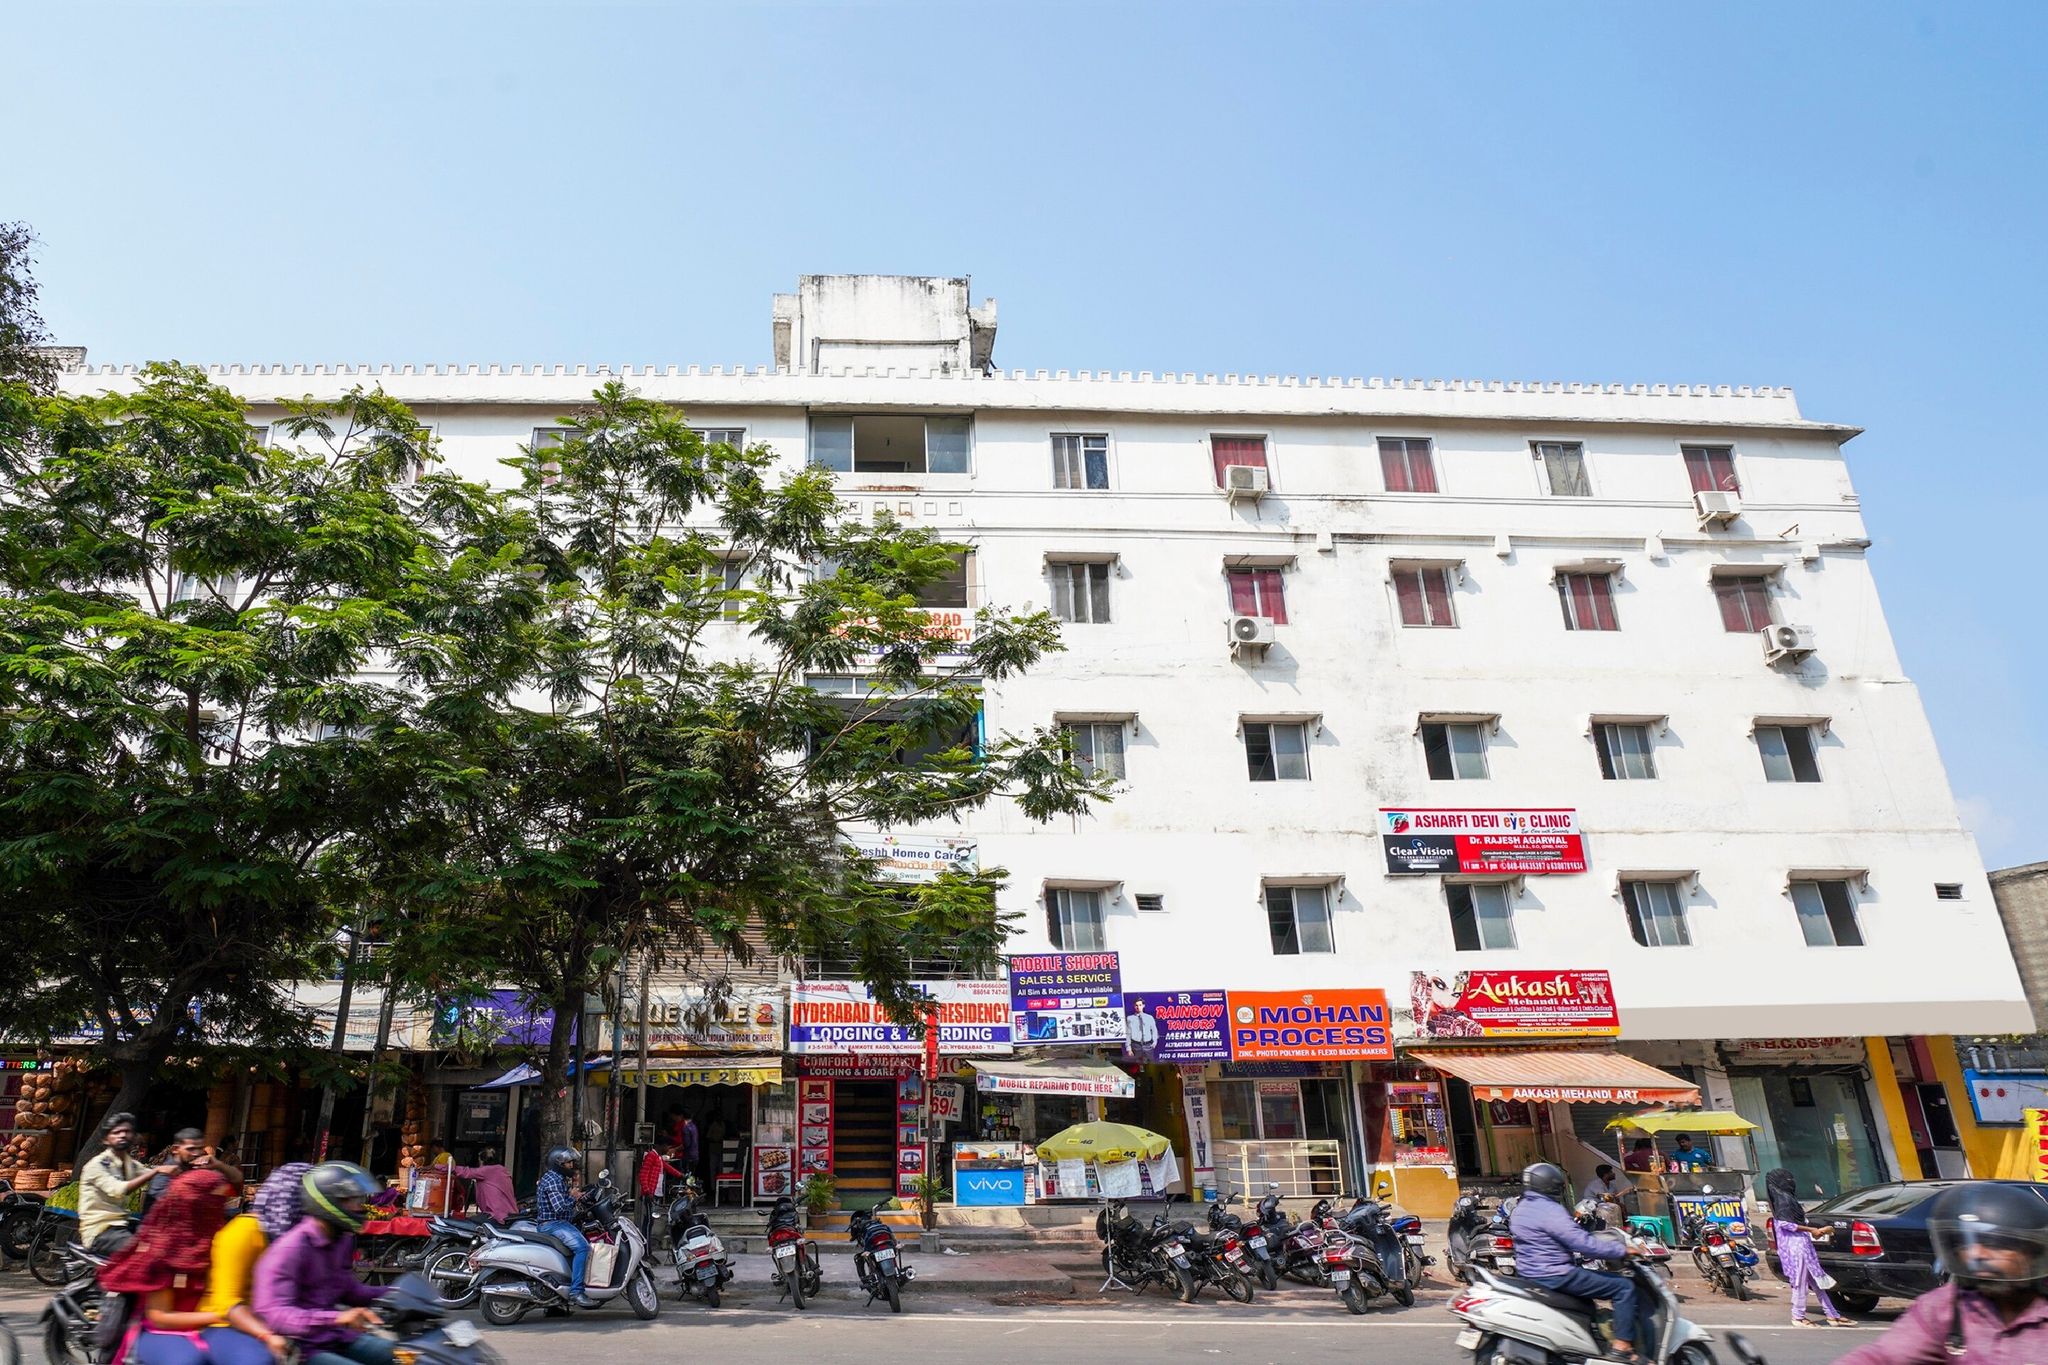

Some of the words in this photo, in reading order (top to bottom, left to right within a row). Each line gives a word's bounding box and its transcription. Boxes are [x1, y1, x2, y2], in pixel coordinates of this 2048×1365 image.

[1415, 815, 1468, 828] ASHARFI
[1472, 815, 1500, 828] DEVI
[1504, 813, 1526, 830] eye
[1530, 814, 1571, 828] CLINIC
[1469, 836, 1482, 844] Dr.
[1484, 836, 1521, 844] RAJESH
[1523, 836, 1567, 844] AGARWAL
[892, 848, 930, 859] Homeo
[934, 850, 961, 860] Care
[1389, 846, 1418, 856] Clear
[1419, 846, 1454, 856] Vision
[1012, 956, 1062, 972] MOBILE
[1065, 954, 1118, 971] SHOPPE
[1020, 976, 1053, 985] SALES
[1056, 976, 1064, 984] &
[1067, 973, 1112, 984] SERVICE
[1049, 987, 1082, 995] Recharges
[1084, 986, 1113, 994] Available
[1468, 975, 1574, 1003] Aakash
[756, 1003, 774, 1024] 2
[793, 1003, 870, 1024] HYDERABAD
[940, 1003, 1009, 1024] RESIDENCY
[1156, 1004, 1224, 1020] RAINBOW
[1260, 1006, 1384, 1024] MOHAN
[1167, 1019, 1217, 1030] TAILORS
[752, 1034, 773, 1042] CHINESE
[811, 1027, 888, 1041] LODGING
[891, 1028, 901, 1040] &
[1165, 1031, 1192, 1040] MENS
[1194, 1031, 1220, 1039] WEAR
[1237, 1027, 1386, 1047] PROCESS
[804, 1056, 855, 1067] COMFORT
[667, 1072, 710, 1083] NILE
[719, 1072, 729, 1081] 2
[810, 1068, 852, 1076] LODGING
[854, 1068, 861, 1076] &
[998, 1079, 1027, 1089] MOBILE
[1029, 1080, 1069, 1091] REPAIRING
[1071, 1082, 1091, 1092] DONE
[1094, 1083, 1113, 1093] HERE
[935, 1089, 956, 1097] GLASS
[1513, 1089, 1559, 1098] AAKASH
[1562, 1089, 1611, 1099] MEHANDI
[1616, 1090, 1638, 1099] ART
[968, 1177, 1013, 1190] vivo
